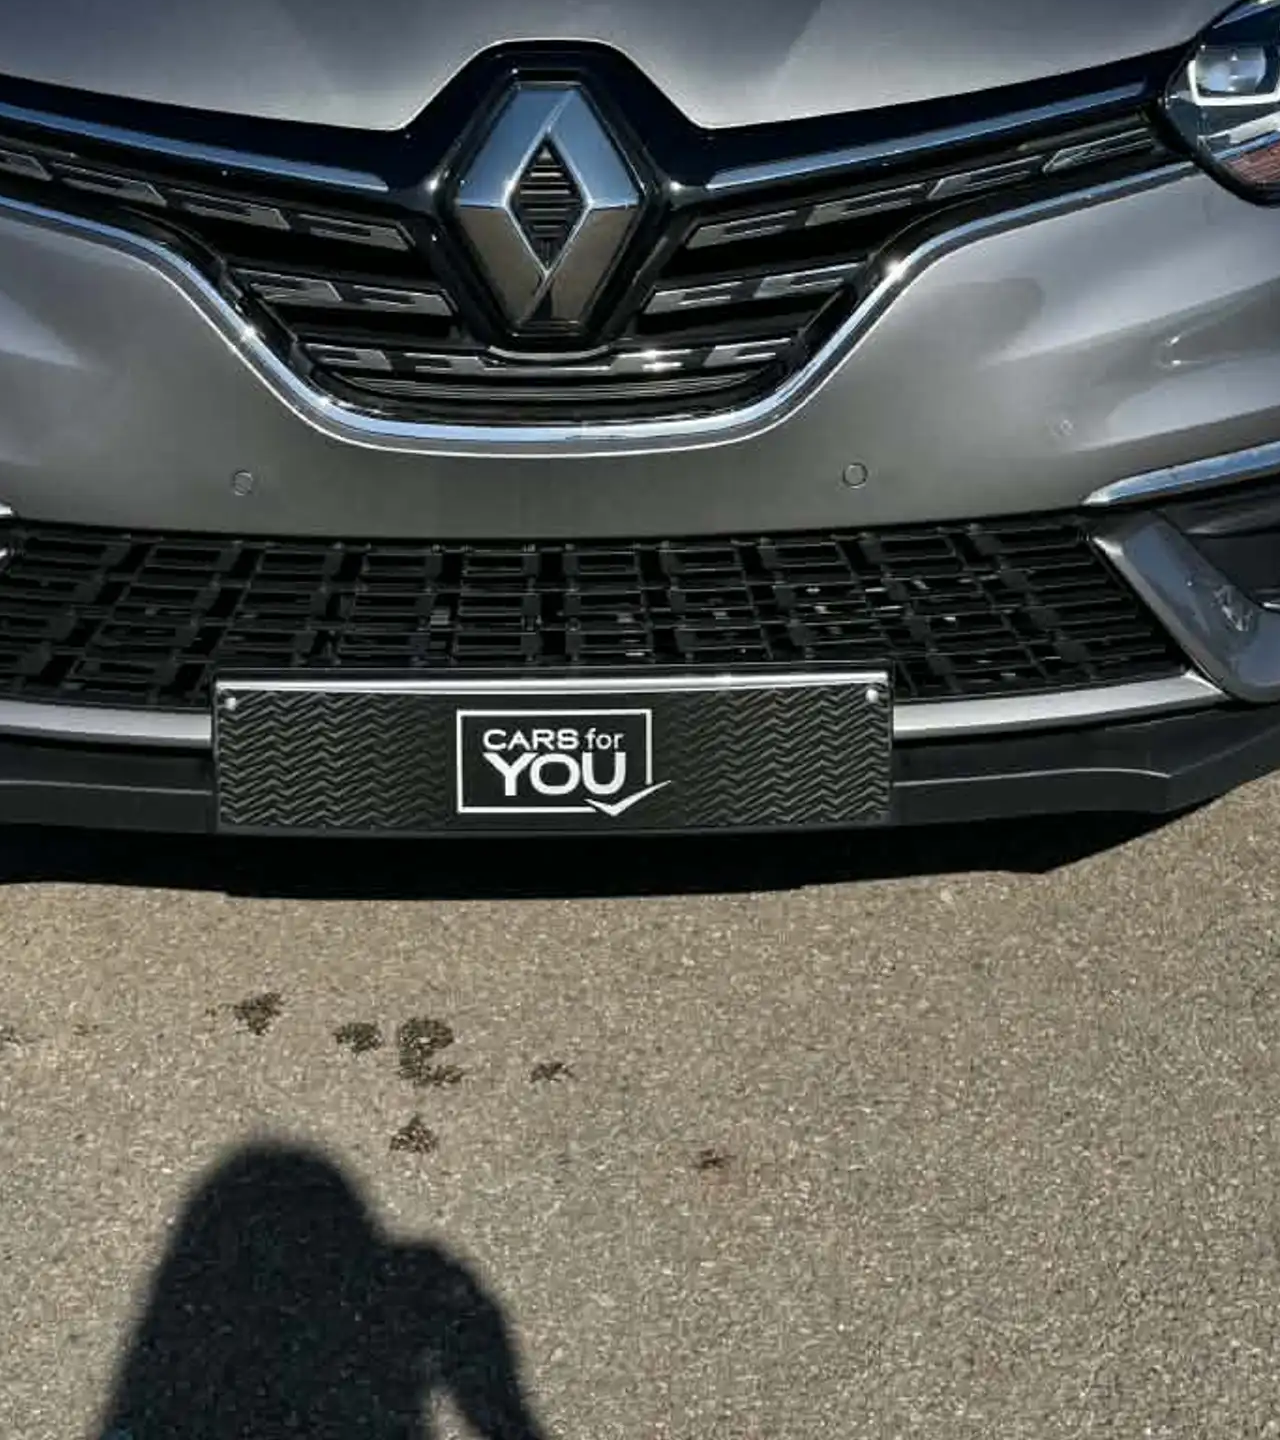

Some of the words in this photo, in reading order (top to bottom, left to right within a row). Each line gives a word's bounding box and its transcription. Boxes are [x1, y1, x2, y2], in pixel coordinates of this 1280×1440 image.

[482, 728, 578, 750] CARS
[583, 728, 624, 750] for
[482, 752, 628, 797] YOU
